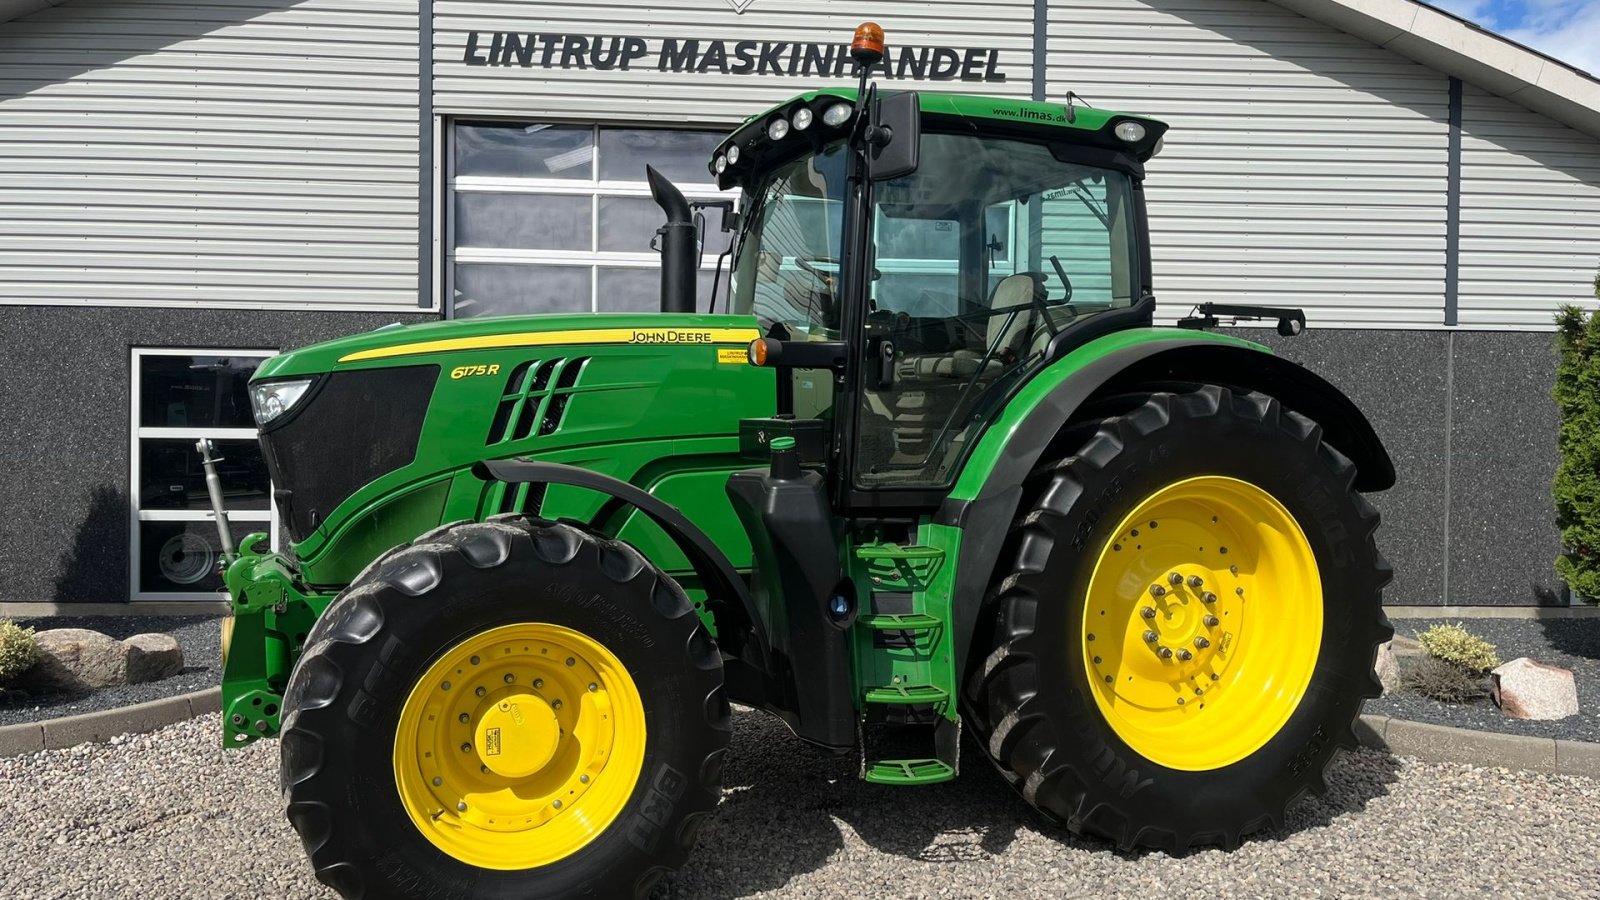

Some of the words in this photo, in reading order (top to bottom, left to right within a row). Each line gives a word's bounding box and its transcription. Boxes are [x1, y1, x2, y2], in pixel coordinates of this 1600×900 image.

[463, 31, 647, 70] LINTRUP
[657, 38, 1006, 82] MASKINHANDEL
[992, 108, 1066, 123] www.limas.dk
[628, 331, 665, 342] JOHN
[667, 331, 712, 342] DEERE
